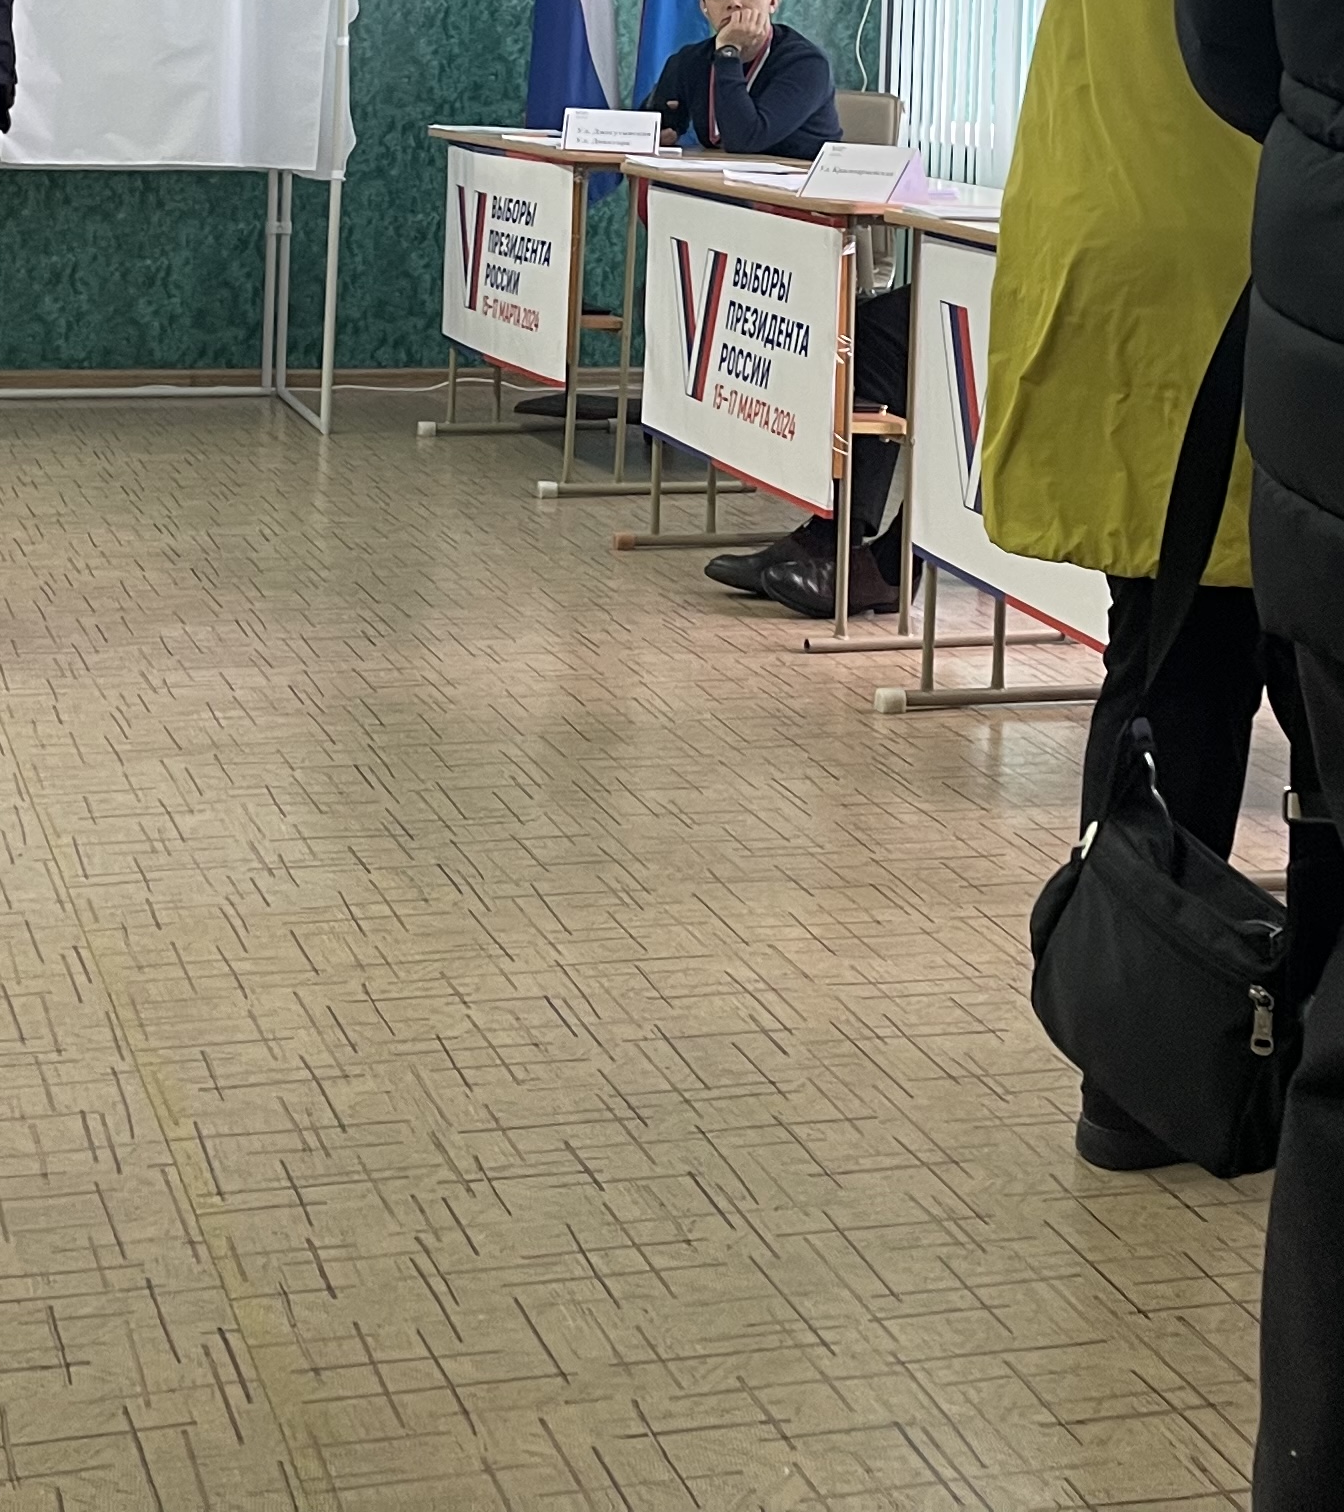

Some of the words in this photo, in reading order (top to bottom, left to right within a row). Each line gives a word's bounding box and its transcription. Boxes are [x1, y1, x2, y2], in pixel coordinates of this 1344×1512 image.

[491, 195, 537, 227] ВЫБОРЫ
[487, 229, 552, 267] ПРЕЗИДЕНТА
[484, 262, 521, 295] РОССИИ
[732, 257, 792, 303] ВЫБОРЫ
[521, 307, 540, 333] 2024
[725, 300, 810, 357] ПРЕЗИДЕНТА
[718, 343, 772, 390] РОССИИ
[737, 393, 771, 430] МАРТА
[771, 407, 796, 442] 2024
